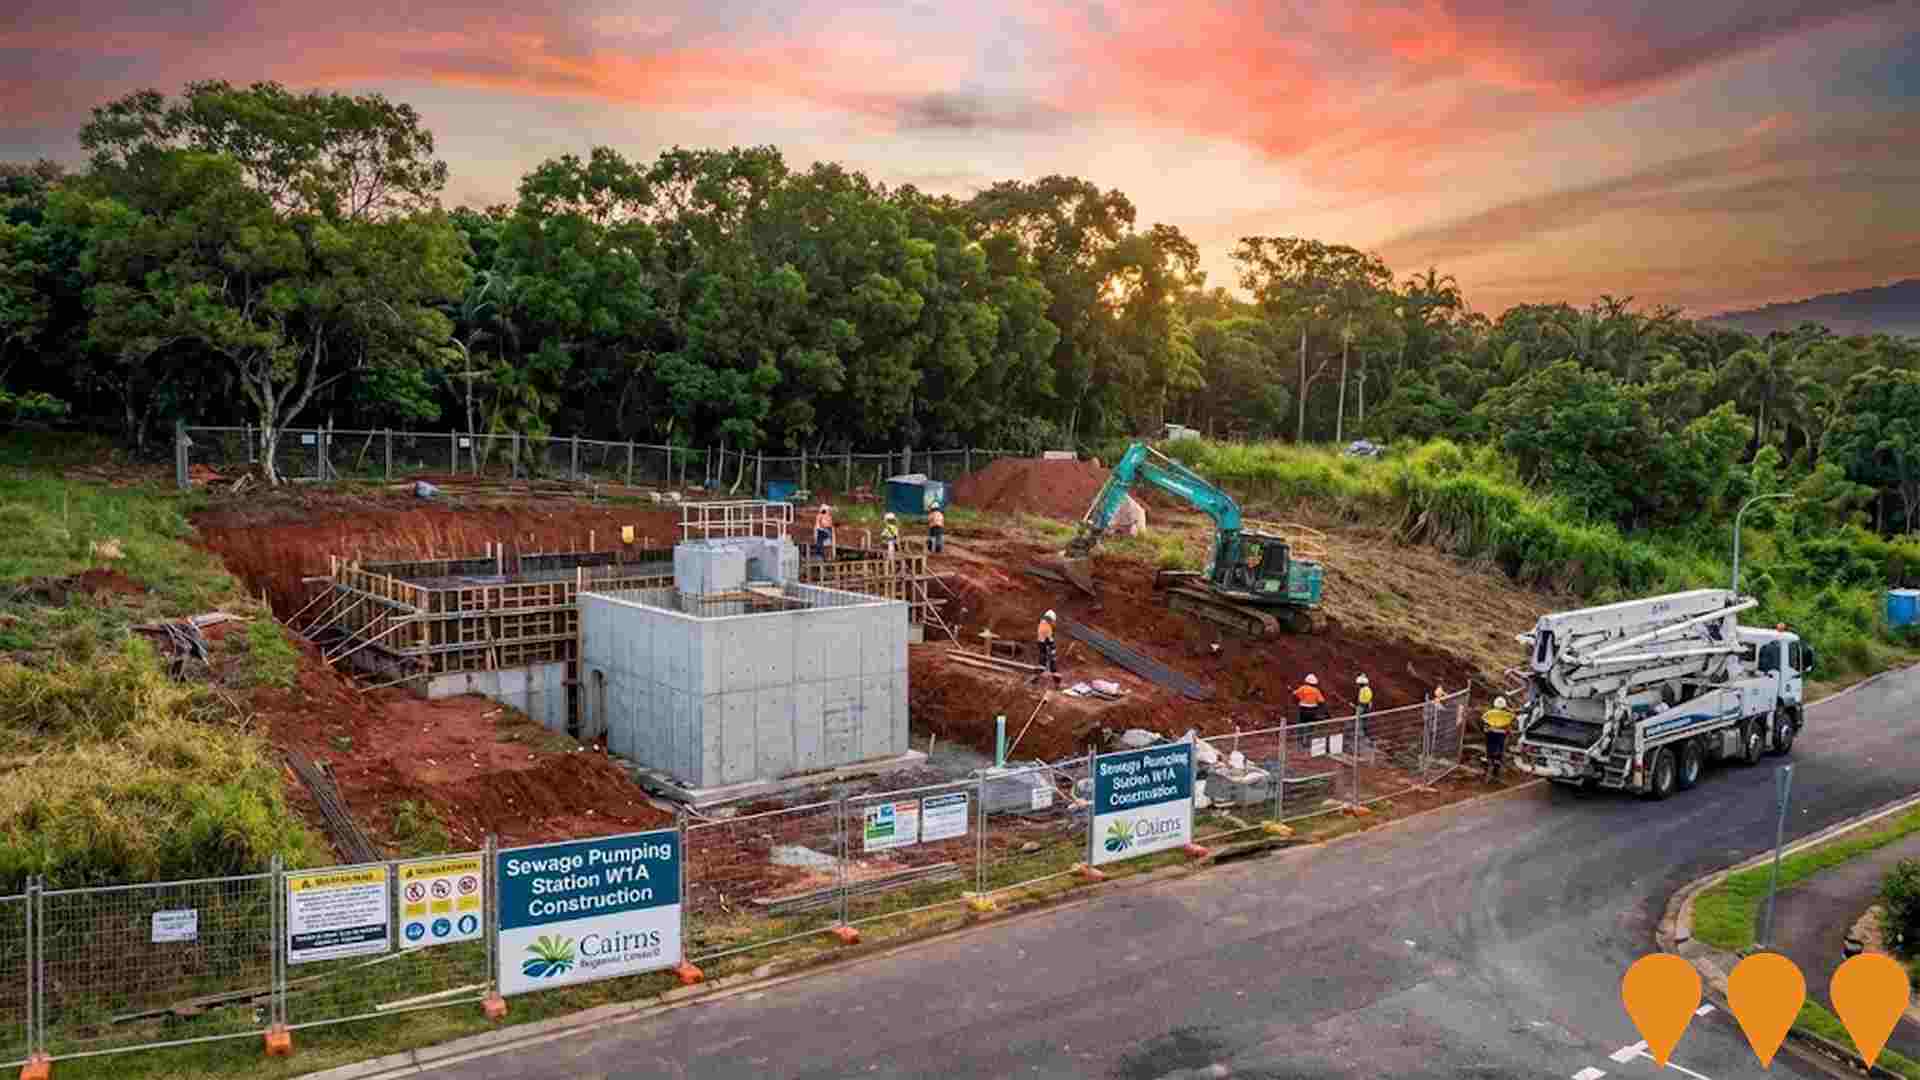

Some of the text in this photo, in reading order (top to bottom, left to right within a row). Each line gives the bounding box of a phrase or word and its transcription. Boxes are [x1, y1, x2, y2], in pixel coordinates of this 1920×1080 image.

[506, 842, 672, 876] Sewage Pumping
[531, 864, 650, 895] Station W1A
[528, 887, 653, 916] Construction
[580, 931, 661, 957] Cairns
